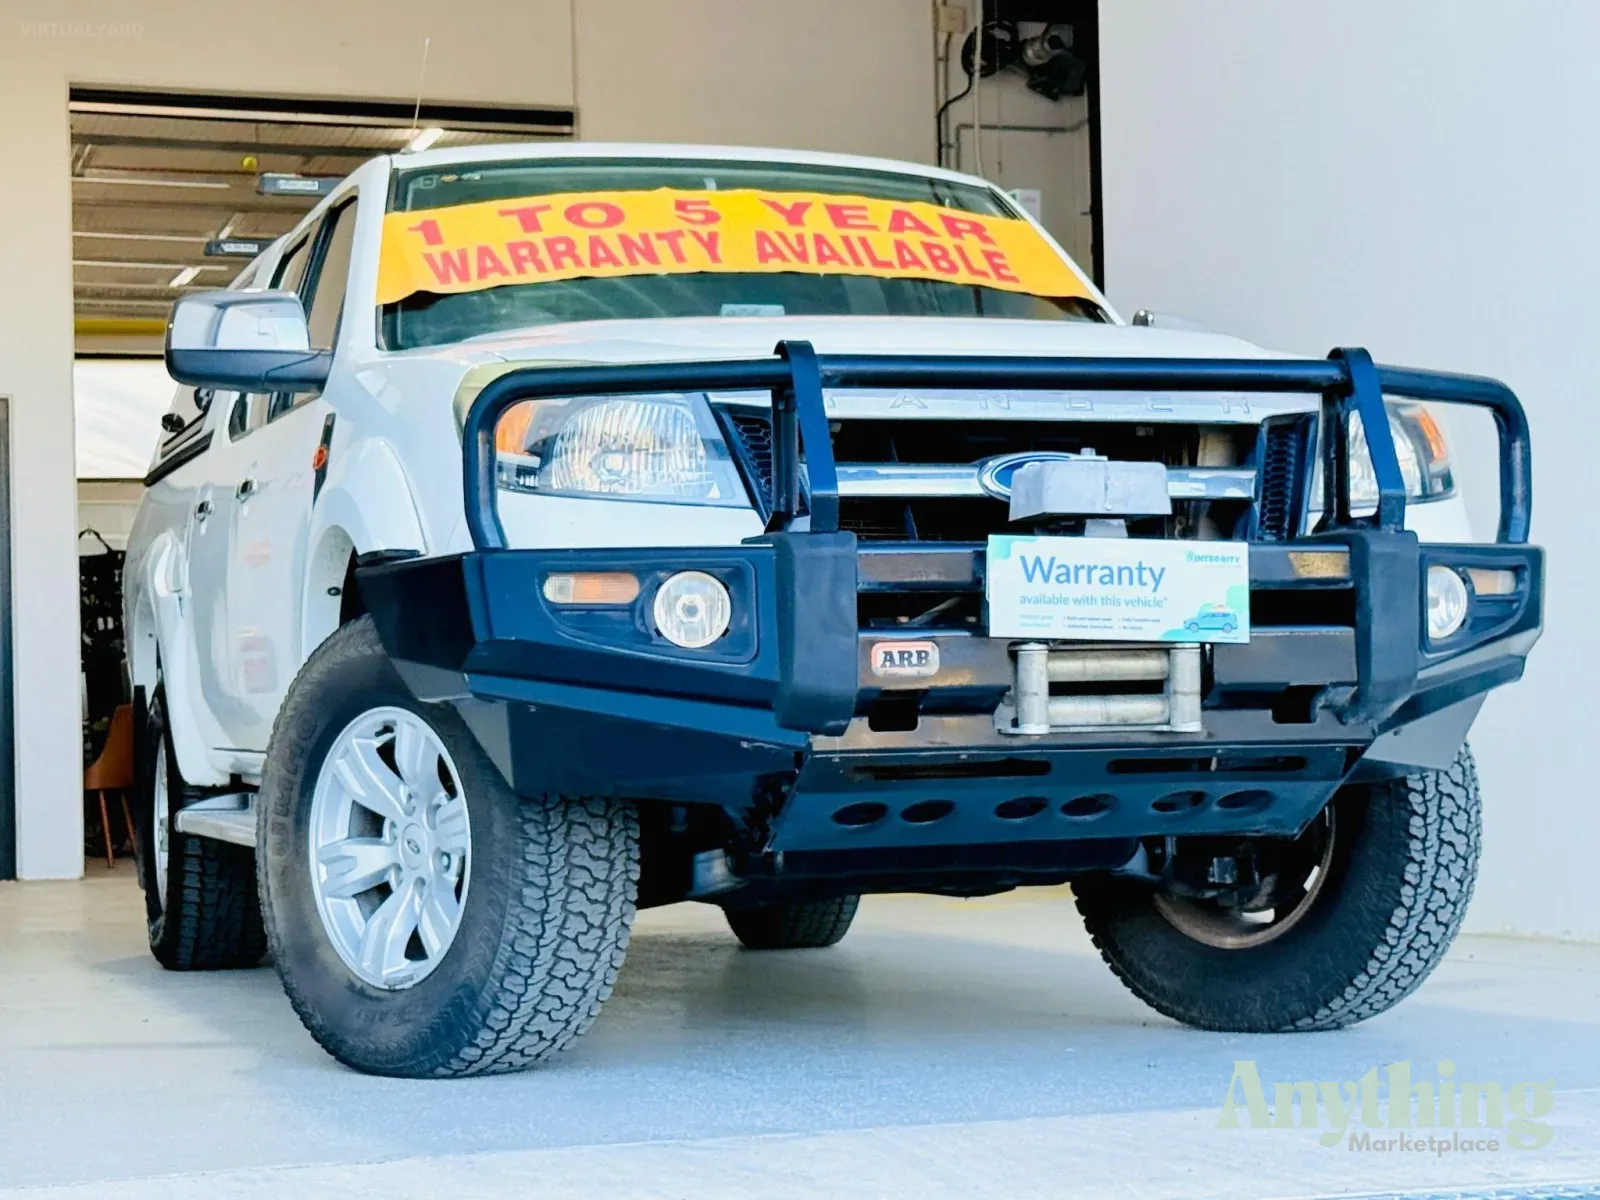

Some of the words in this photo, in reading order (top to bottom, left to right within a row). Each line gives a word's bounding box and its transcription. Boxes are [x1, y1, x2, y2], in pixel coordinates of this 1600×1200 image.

[408, 219, 444, 245] 1
[498, 202, 626, 233] TO
[675, 199, 721, 225] 5
[759, 198, 998, 246] YEAR
[422, 229, 723, 285] WARRANTY
[754, 230, 1021, 283] AVAILABLE
[1020, 555, 1166, 593] Warranty
[1019, 594, 1070, 605] available
[1072, 594, 1098, 606] with
[1100, 594, 1122, 607] this
[880, 650, 930, 668] ARB
